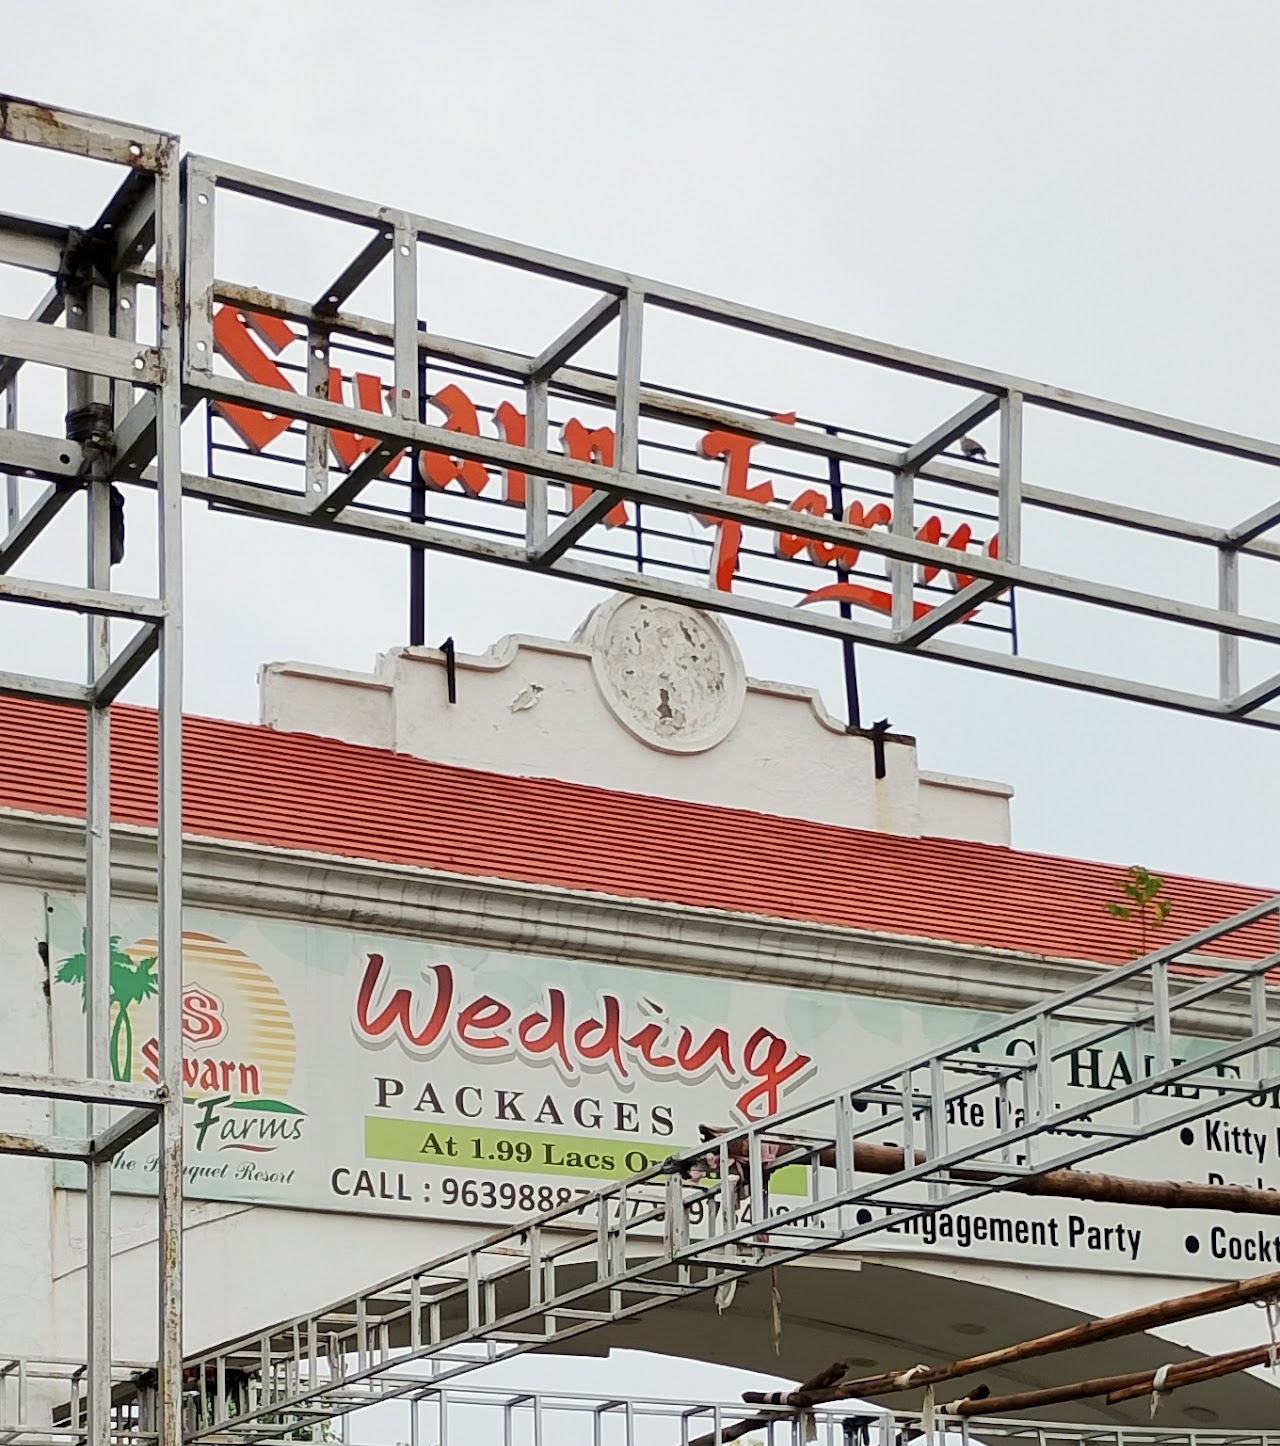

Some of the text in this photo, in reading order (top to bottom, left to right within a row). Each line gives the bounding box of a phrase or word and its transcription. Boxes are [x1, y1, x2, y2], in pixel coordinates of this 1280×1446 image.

[357, 953, 812, 1122] Wedding
[194, 1095, 305, 1151] Farms
[374, 1077, 675, 1136] PACKAGES
[419, 1132, 459, 1157] At
[471, 1138, 533, 1163] 1.99
[542, 1143, 615, 1171] Lacs
[1205, 1119, 1267, 1164] Kitty
[235, 1160, 295, 1184] Resort
[331, 1168, 412, 1201] CALL
[1069, 1215, 1141, 1260] Party
